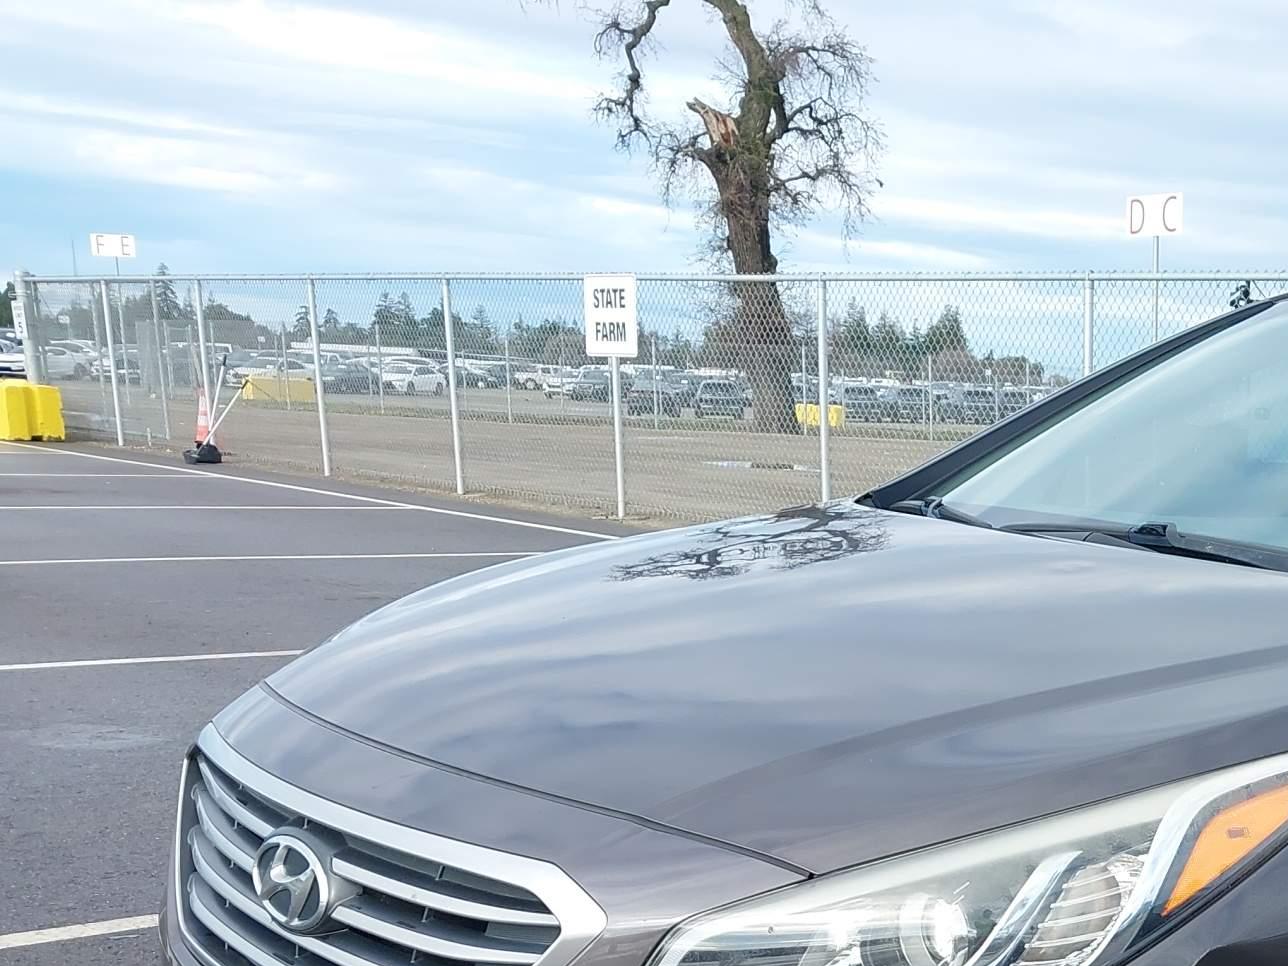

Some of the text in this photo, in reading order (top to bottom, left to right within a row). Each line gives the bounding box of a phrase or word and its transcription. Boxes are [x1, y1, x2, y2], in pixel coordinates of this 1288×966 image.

[1130, 196, 1177, 234] D C
[96, 235, 131, 256] F E
[593, 288, 626, 309] STATE
[595, 321, 627, 342] FARM
